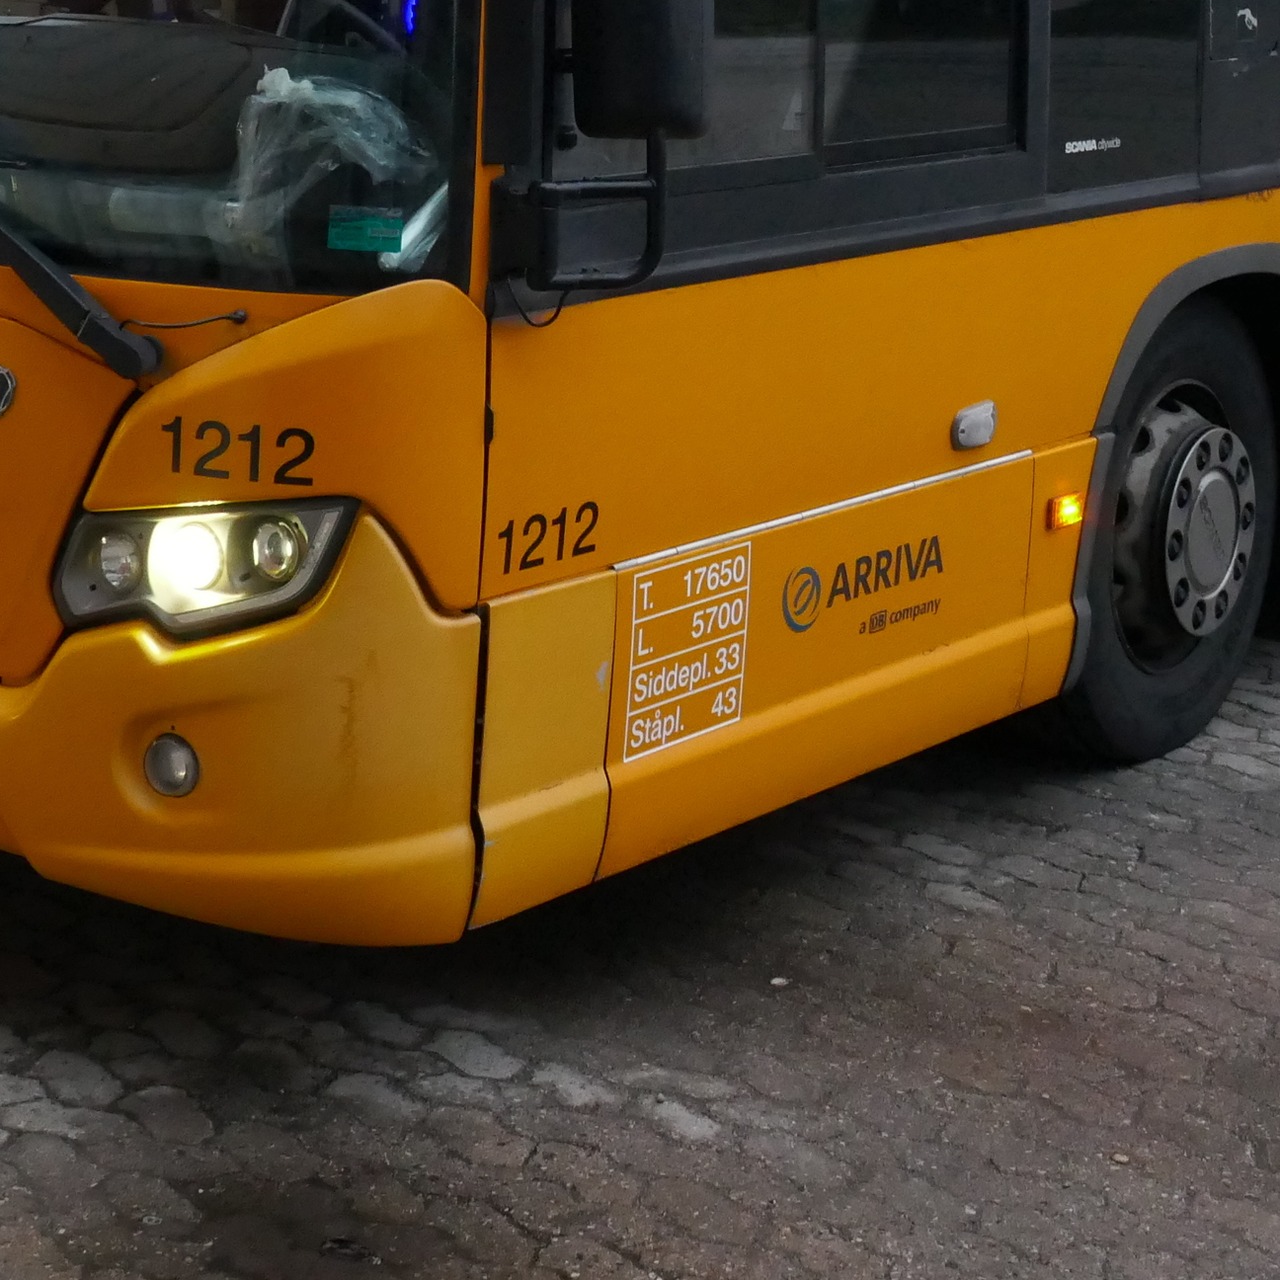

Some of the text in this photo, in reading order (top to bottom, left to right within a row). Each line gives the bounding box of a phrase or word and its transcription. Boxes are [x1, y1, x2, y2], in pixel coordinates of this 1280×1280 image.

[1065, 139, 1097, 153] SCANIA
[161, 416, 316, 487] 1212
[498, 501, 600, 575] 1212
[638, 555, 746, 611] T. 17650
[826, 535, 944, 608] ARRIVA
[637, 598, 744, 657] L. 5700
[870, 611, 887, 632] DB
[889, 598, 943, 627] company
[633, 643, 741, 703] Siddepl. 33
[630, 686, 738, 749] Ståpl. 43
